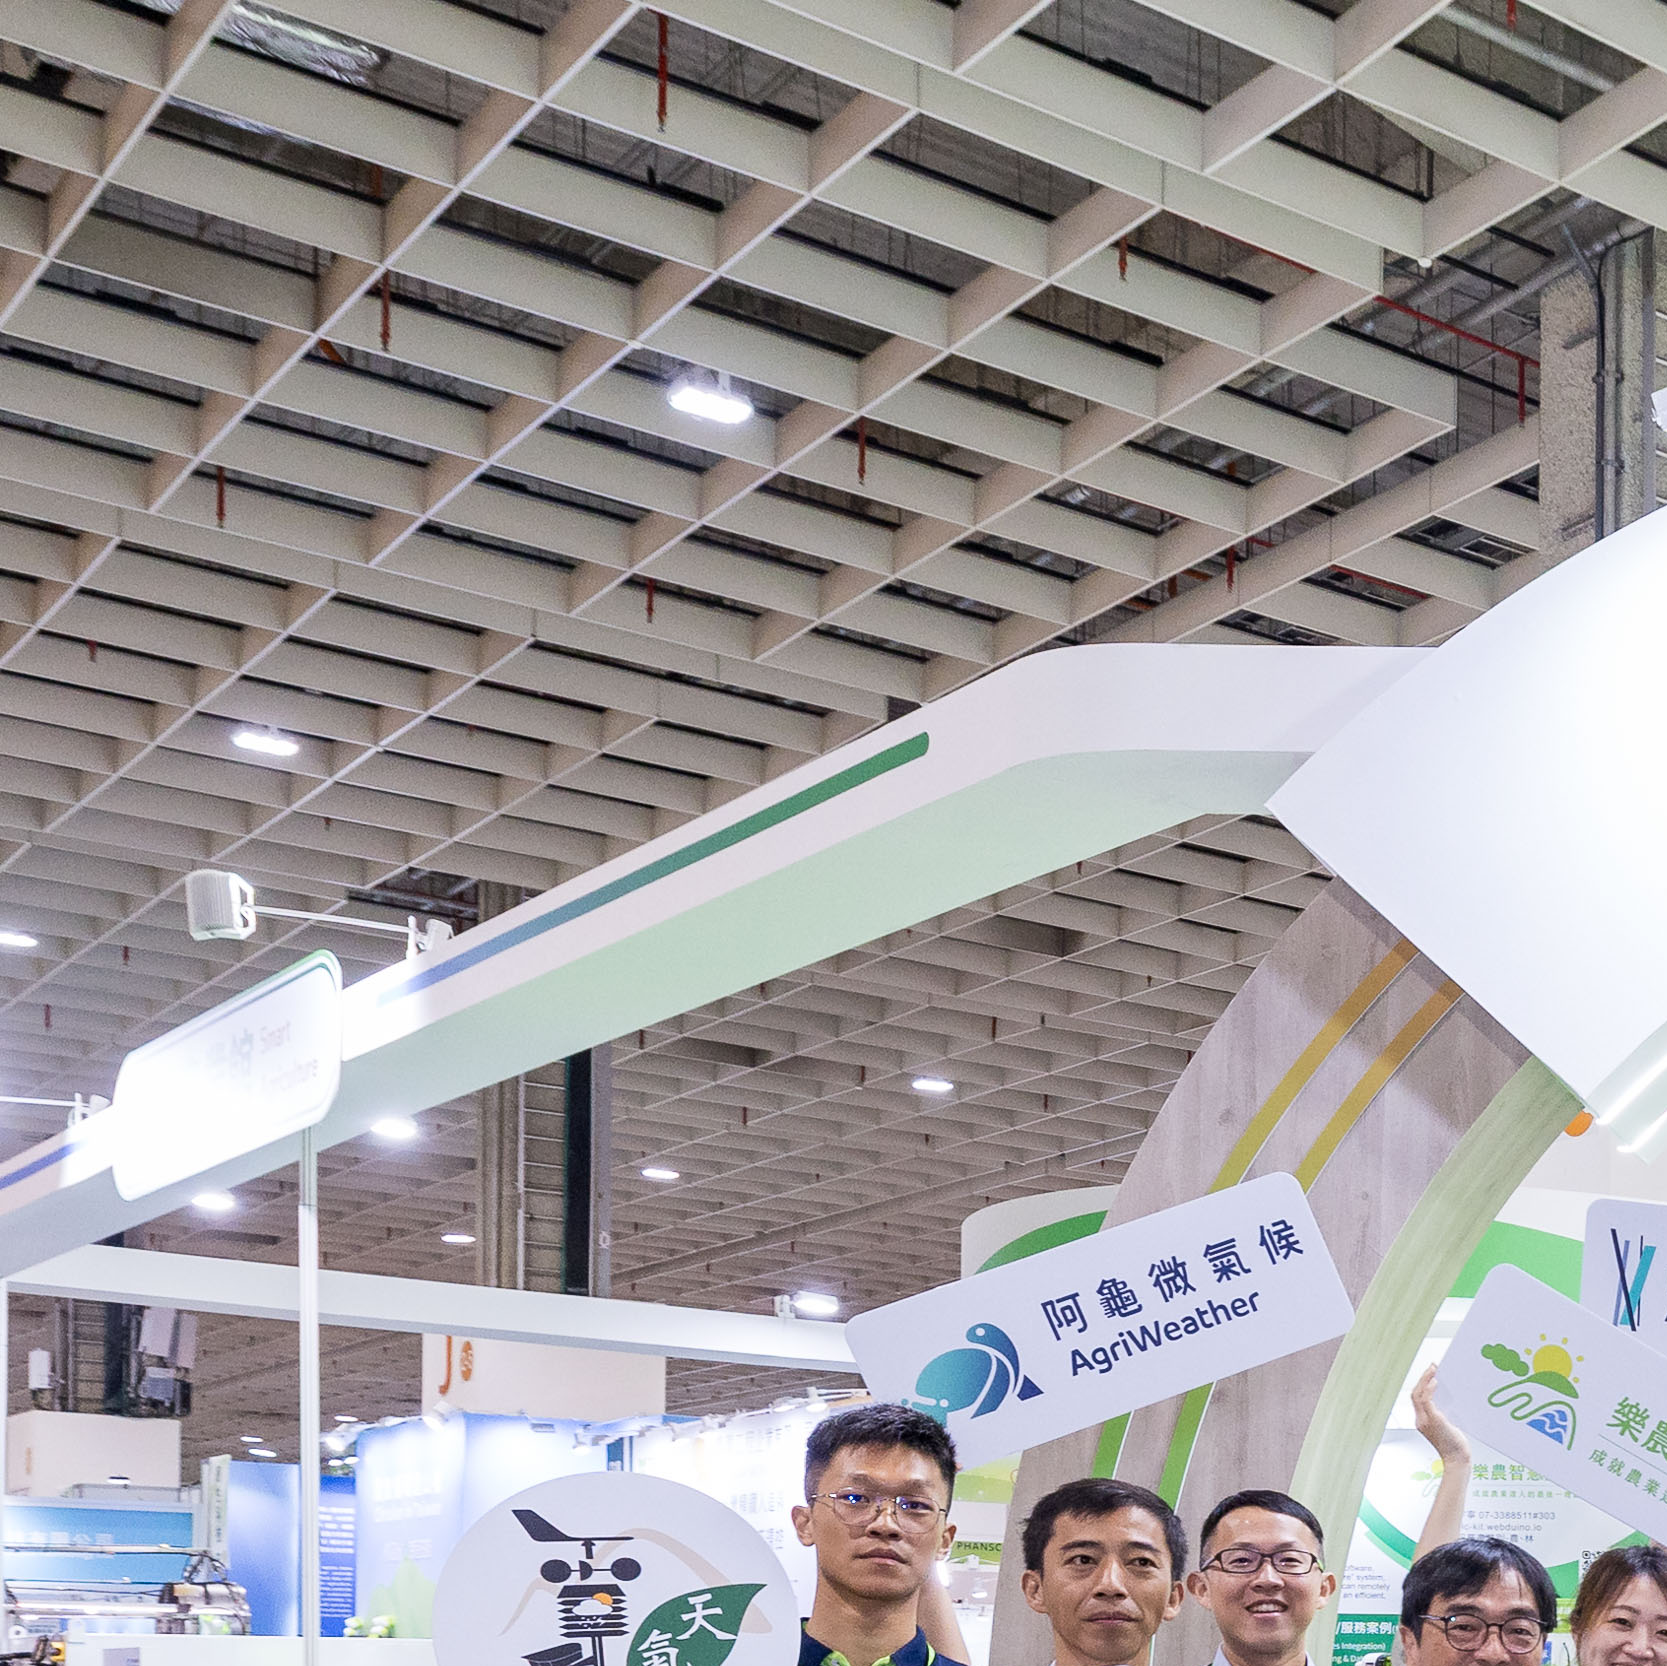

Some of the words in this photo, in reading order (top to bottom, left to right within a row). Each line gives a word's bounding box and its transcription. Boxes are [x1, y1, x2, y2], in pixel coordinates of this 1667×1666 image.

[1041, 1218, 1303, 1341] 阿龜微氣候
[1070, 1290, 1260, 1378] AgriWeather
